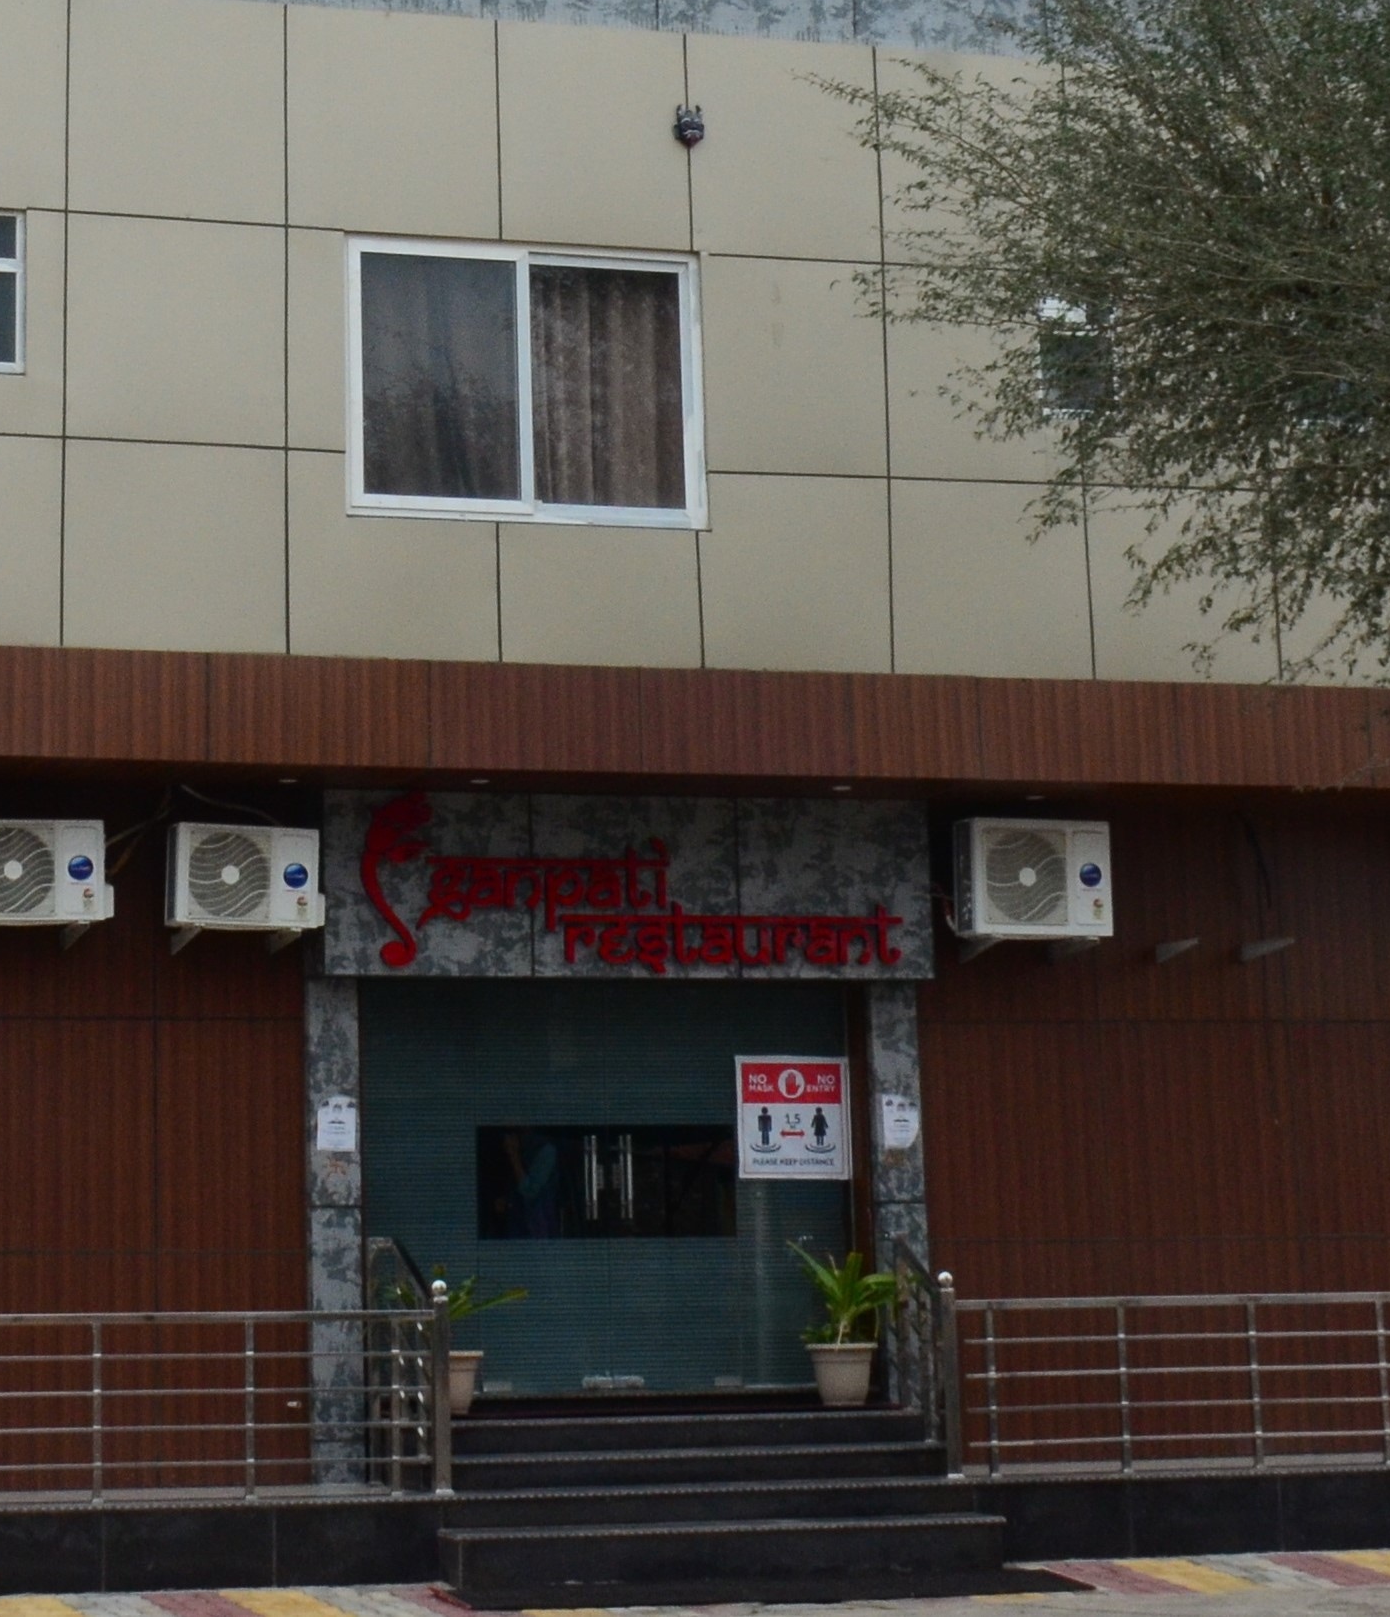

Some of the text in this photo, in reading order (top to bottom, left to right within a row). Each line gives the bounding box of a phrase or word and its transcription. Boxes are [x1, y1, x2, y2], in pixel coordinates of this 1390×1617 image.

[416, 836, 670, 932] ganpati
[558, 901, 904, 974] restaurant
[748, 1073, 767, 1084] NO
[817, 1074, 836, 1085] NO
[748, 1084, 775, 1093] MASK
[806, 1084, 836, 1093] ENTRY
